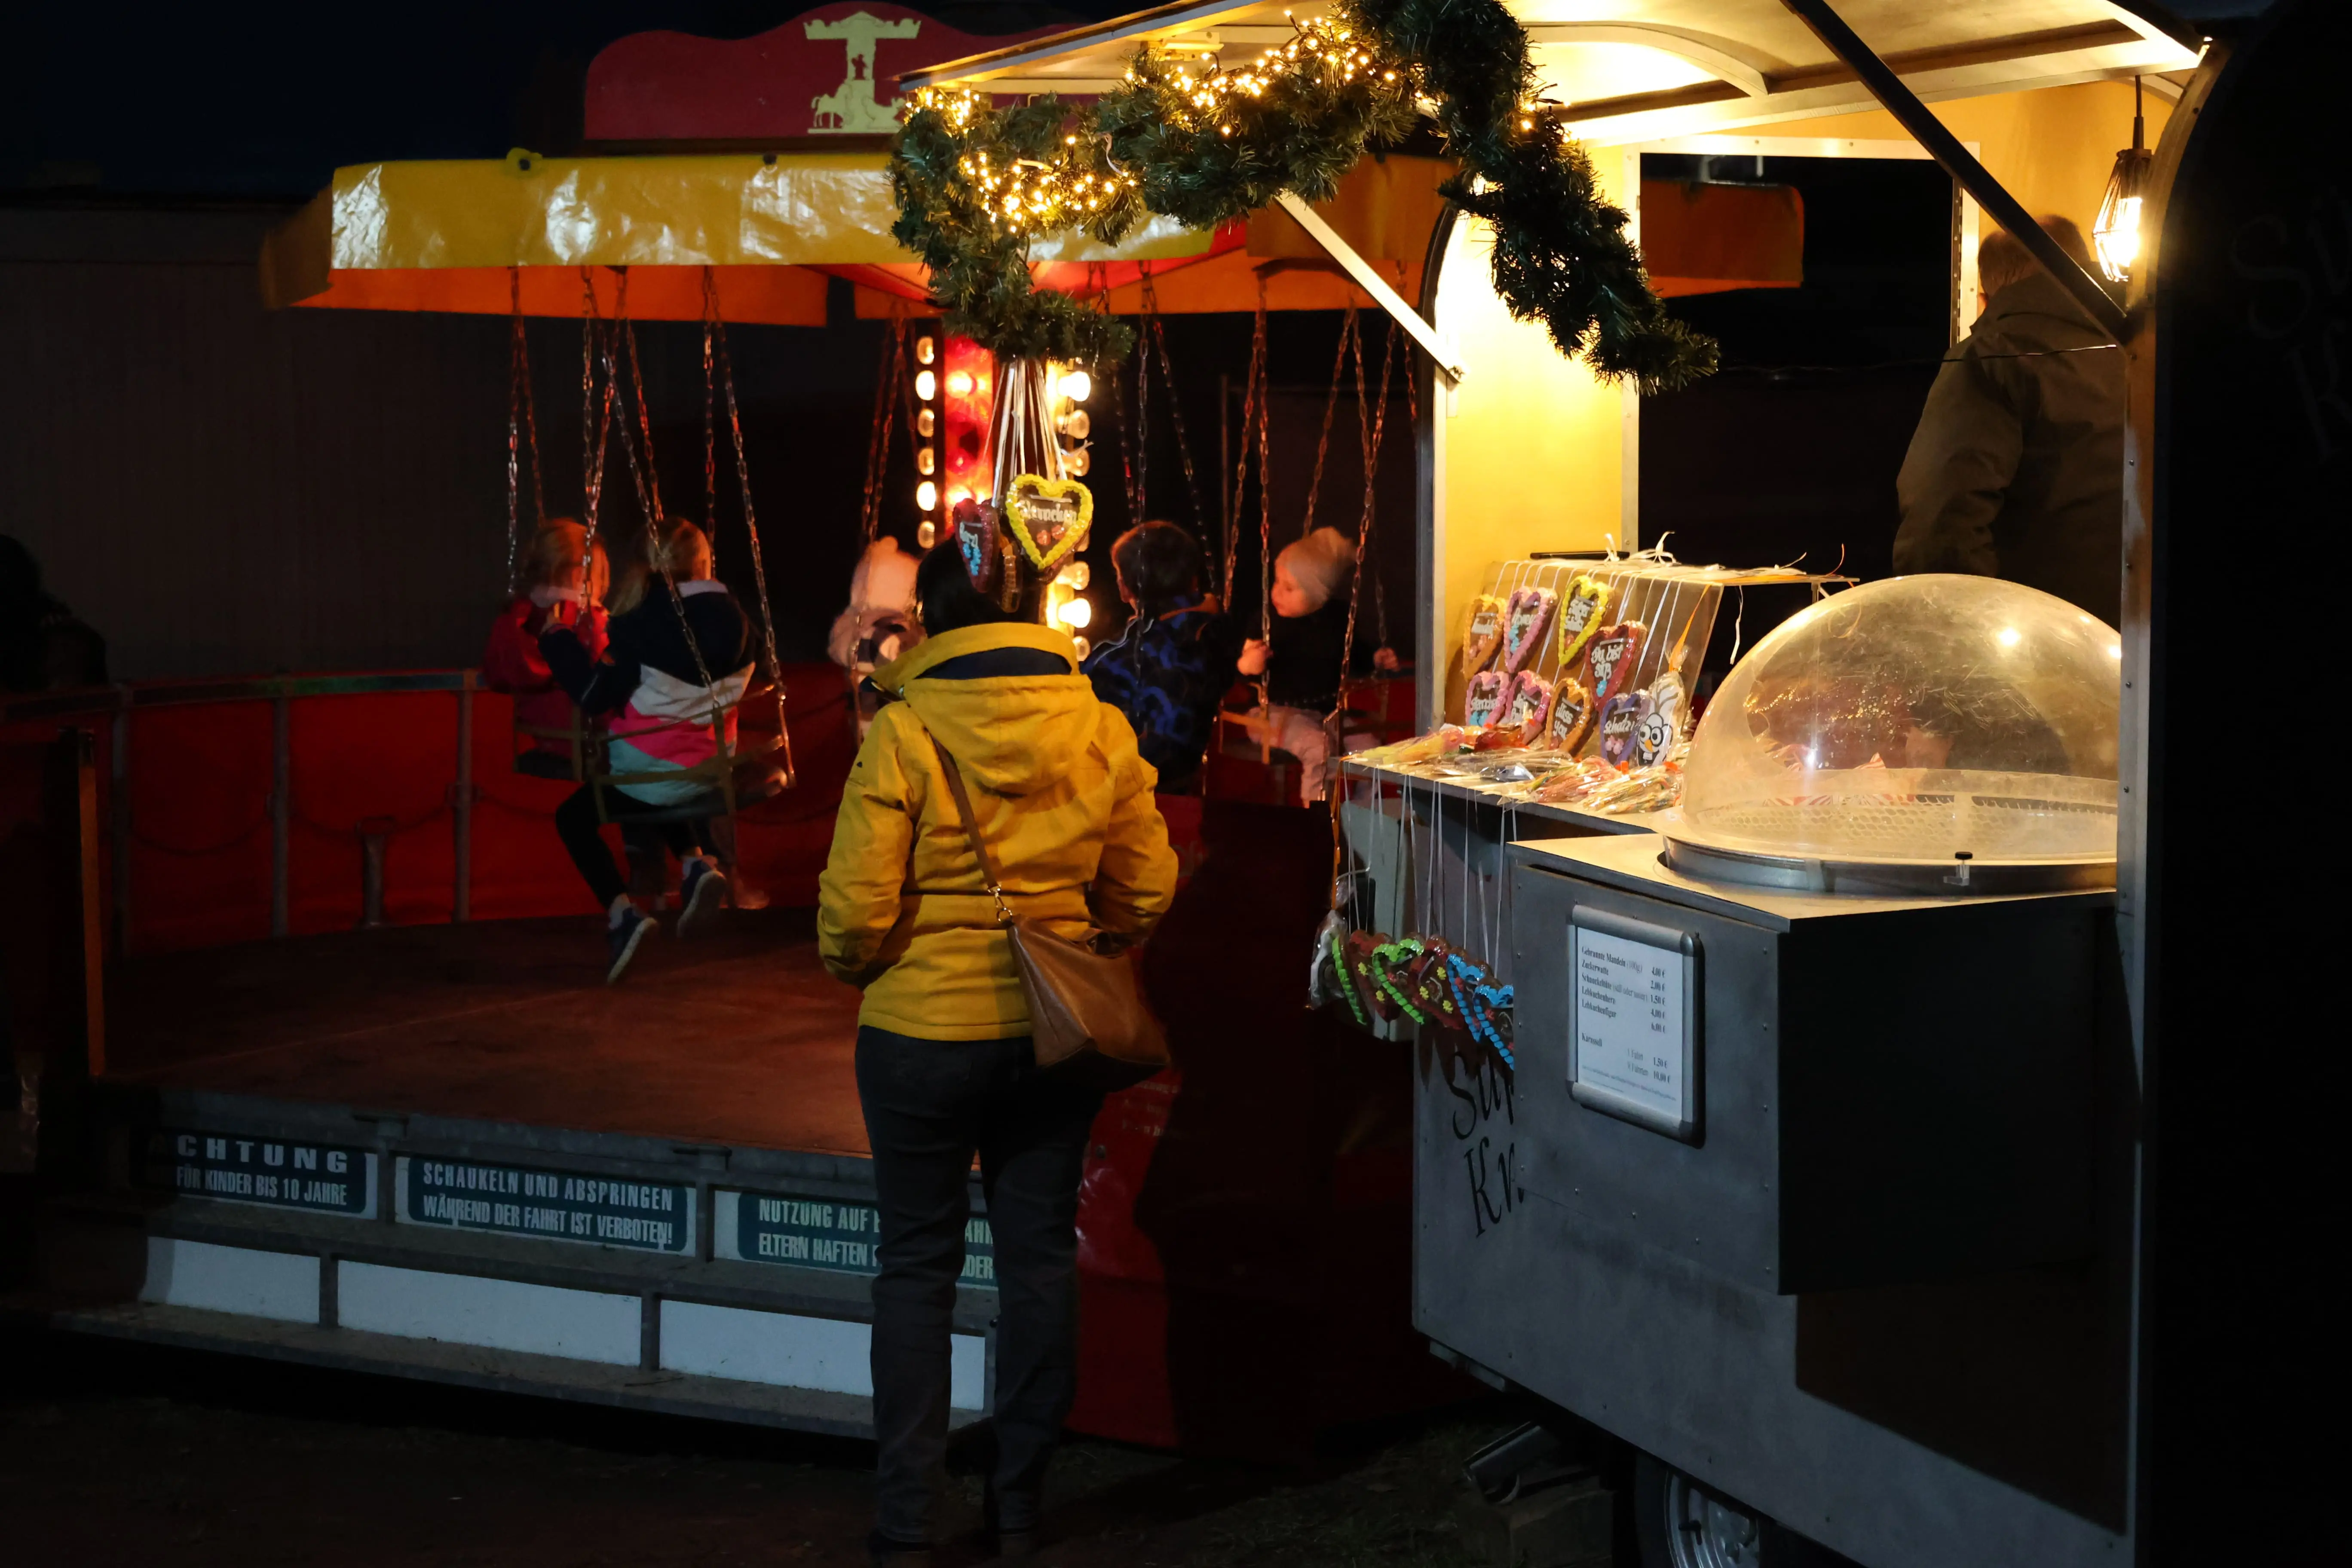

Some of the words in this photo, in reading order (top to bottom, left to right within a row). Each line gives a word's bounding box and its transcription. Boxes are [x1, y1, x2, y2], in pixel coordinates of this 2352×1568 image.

[1582, 946, 1605, 961] Gebrannte
[1607, 952, 1626, 967] Mandeln
[1582, 959, 1609, 976] Zuckerwatte
[1582, 986, 1616, 1004] Lebkuchenherz
[1582, 998, 1617, 1019] Lebkuchenfigur
[1582, 1032, 1602, 1047] Karussell
[176, 1134, 348, 1174] CHTUNG
[177, 1163, 201, 1190] FÜR
[205, 1169, 252, 1195] KINDER
[256, 1174, 278, 1199] BIS
[282, 1178, 300, 1201] 10
[303, 1180, 347, 1206] JAHRE
[423, 1163, 518, 1194] SCHAUKELN
[524, 1173, 558, 1198] UND
[564, 1177, 672, 1212] ABSPRINGEN
[423, 1192, 490, 1223] WÄHREND
[495, 1203, 520, 1228] DER
[524, 1206, 565, 1232] FAHRT
[570, 1212, 591, 1235] IST
[597, 1215, 672, 1245] VERBOTEN!
[759, 1198, 833, 1228] NUTZUNG
[838, 1207, 868, 1232] AUF
[758, 1233, 808, 1260] ELTERN
[813, 1238, 868, 1266] HAFTEN
[960, 1253, 993, 1280] DER
